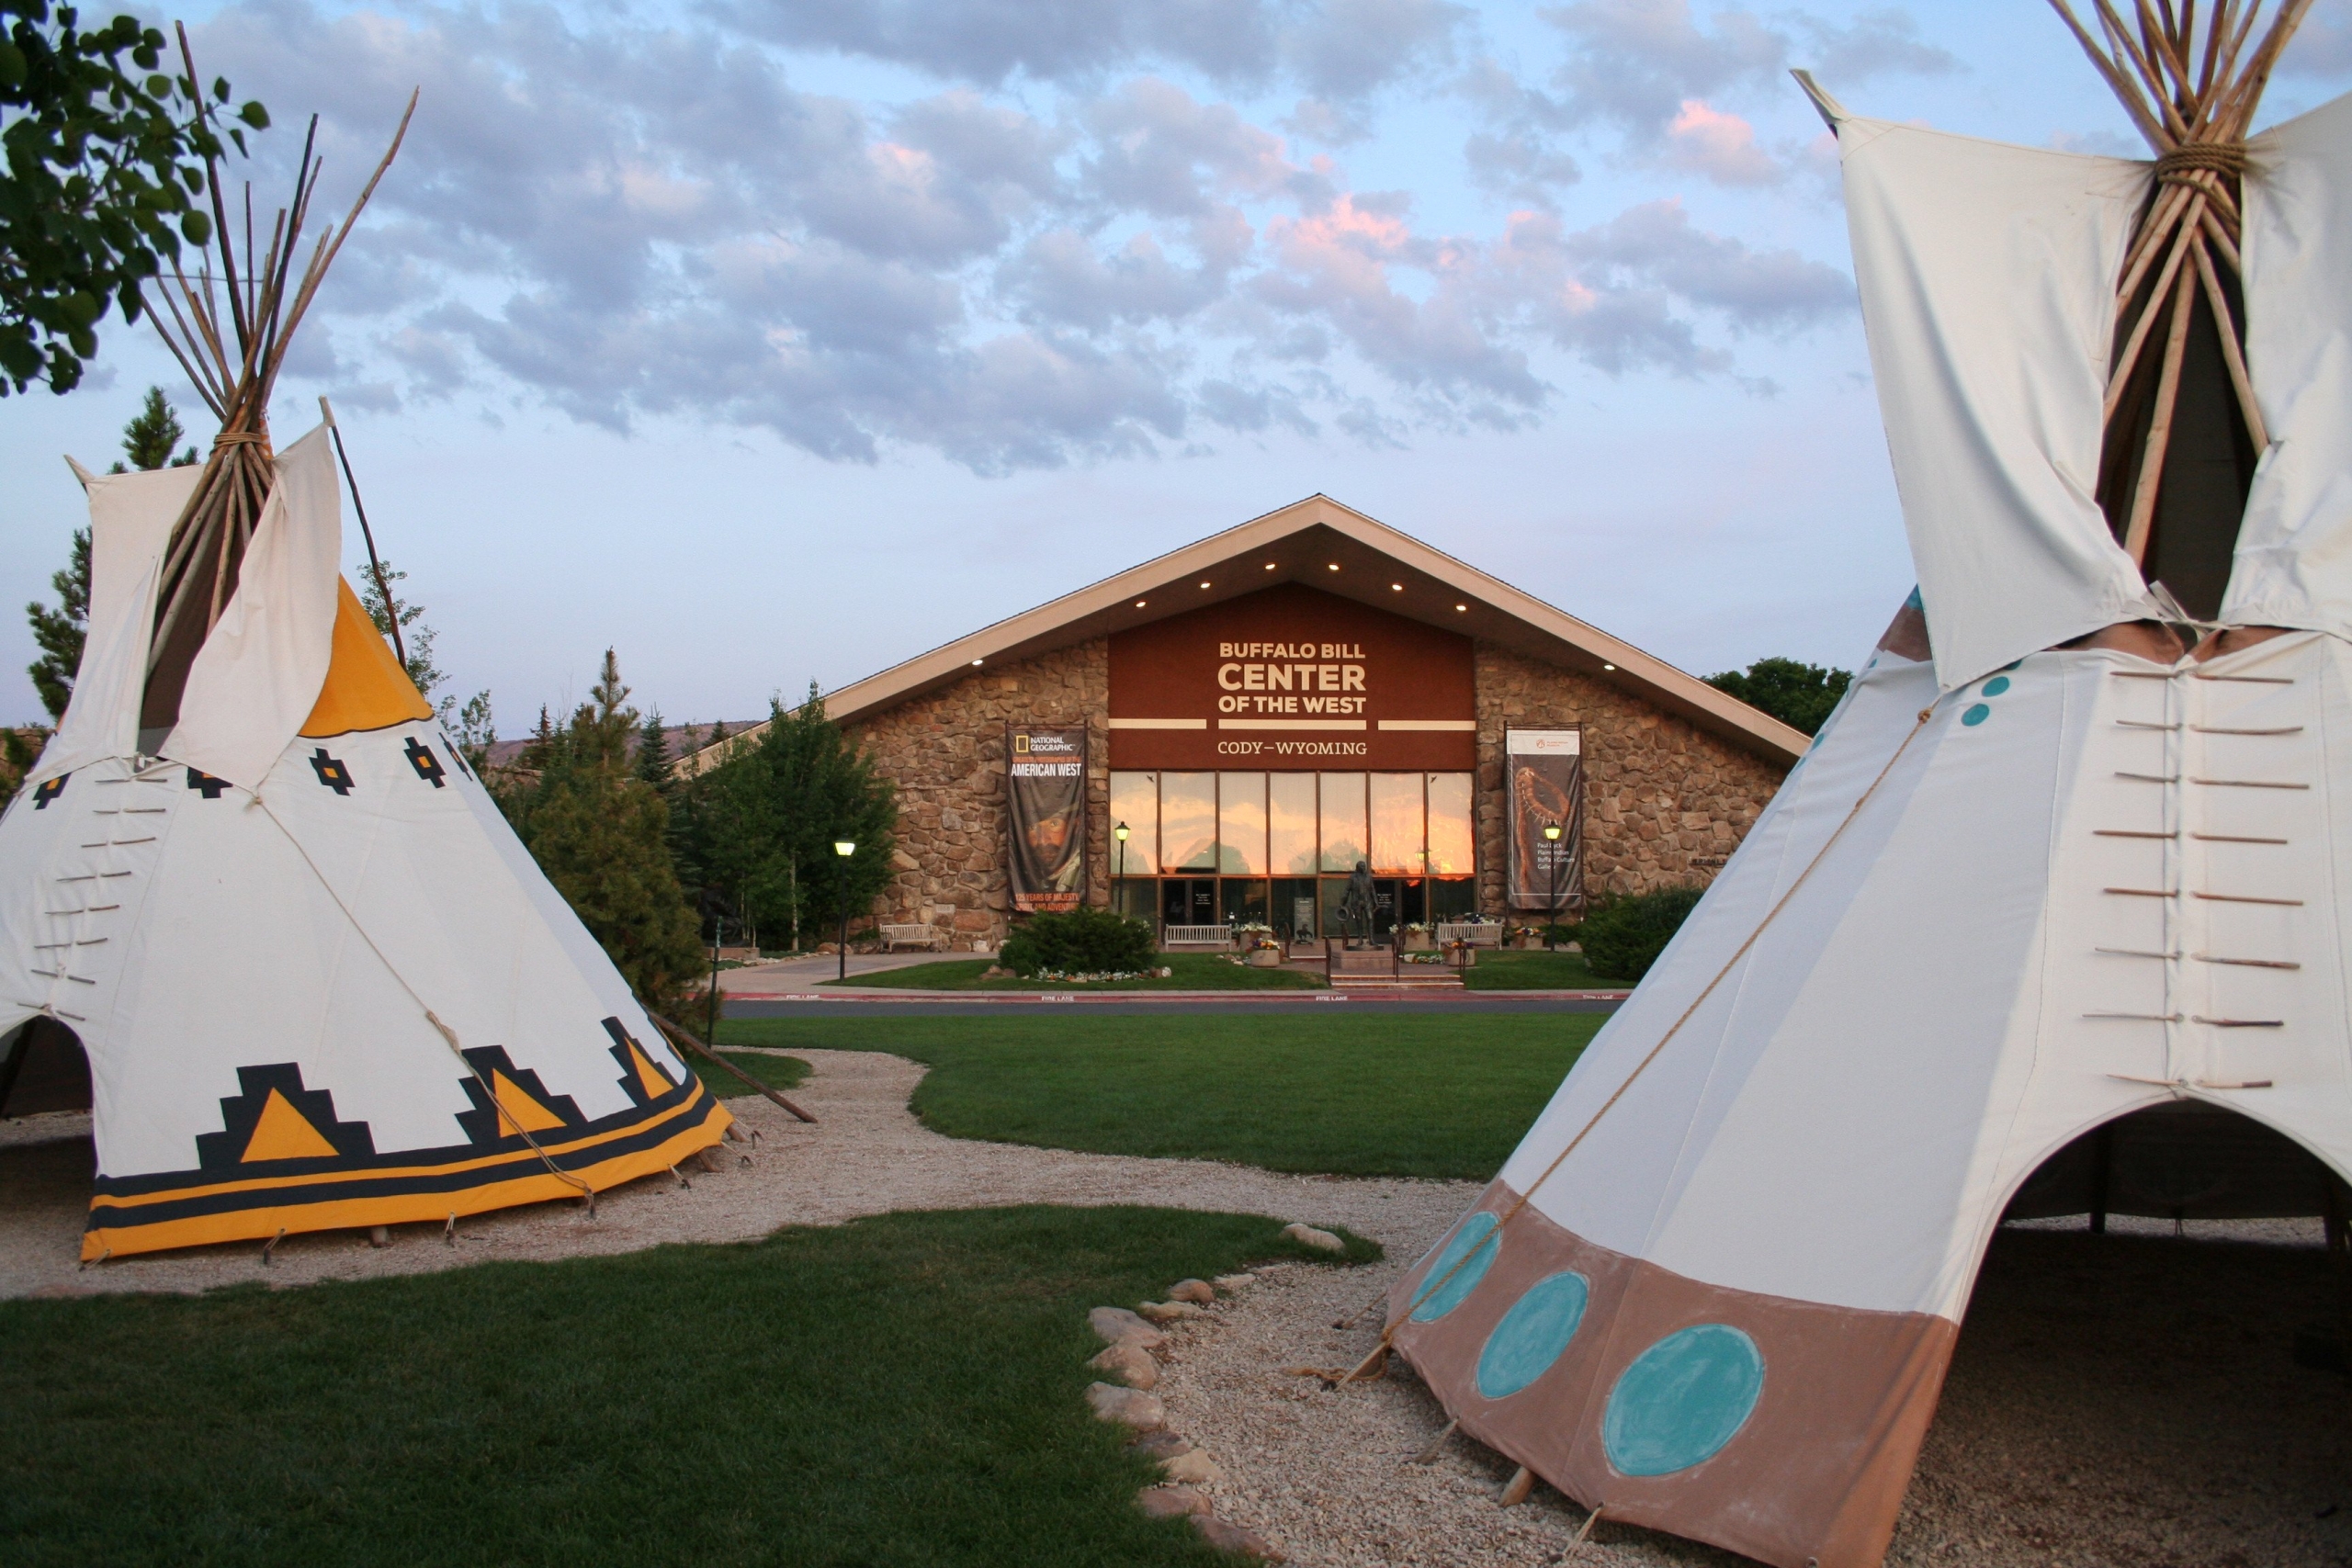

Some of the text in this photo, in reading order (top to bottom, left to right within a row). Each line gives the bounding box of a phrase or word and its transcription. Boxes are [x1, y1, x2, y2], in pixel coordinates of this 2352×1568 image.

[1219, 642, 1366, 659] BUFFALO BILL
[1217, 662, 1367, 692] CENTER
[1218, 695, 1367, 714] OF THE WEST
[1011, 762, 1081, 777] AMERICAN WEST
[1026, 893, 1045, 902] YEARS
[1045, 893, 1053, 902] OF
